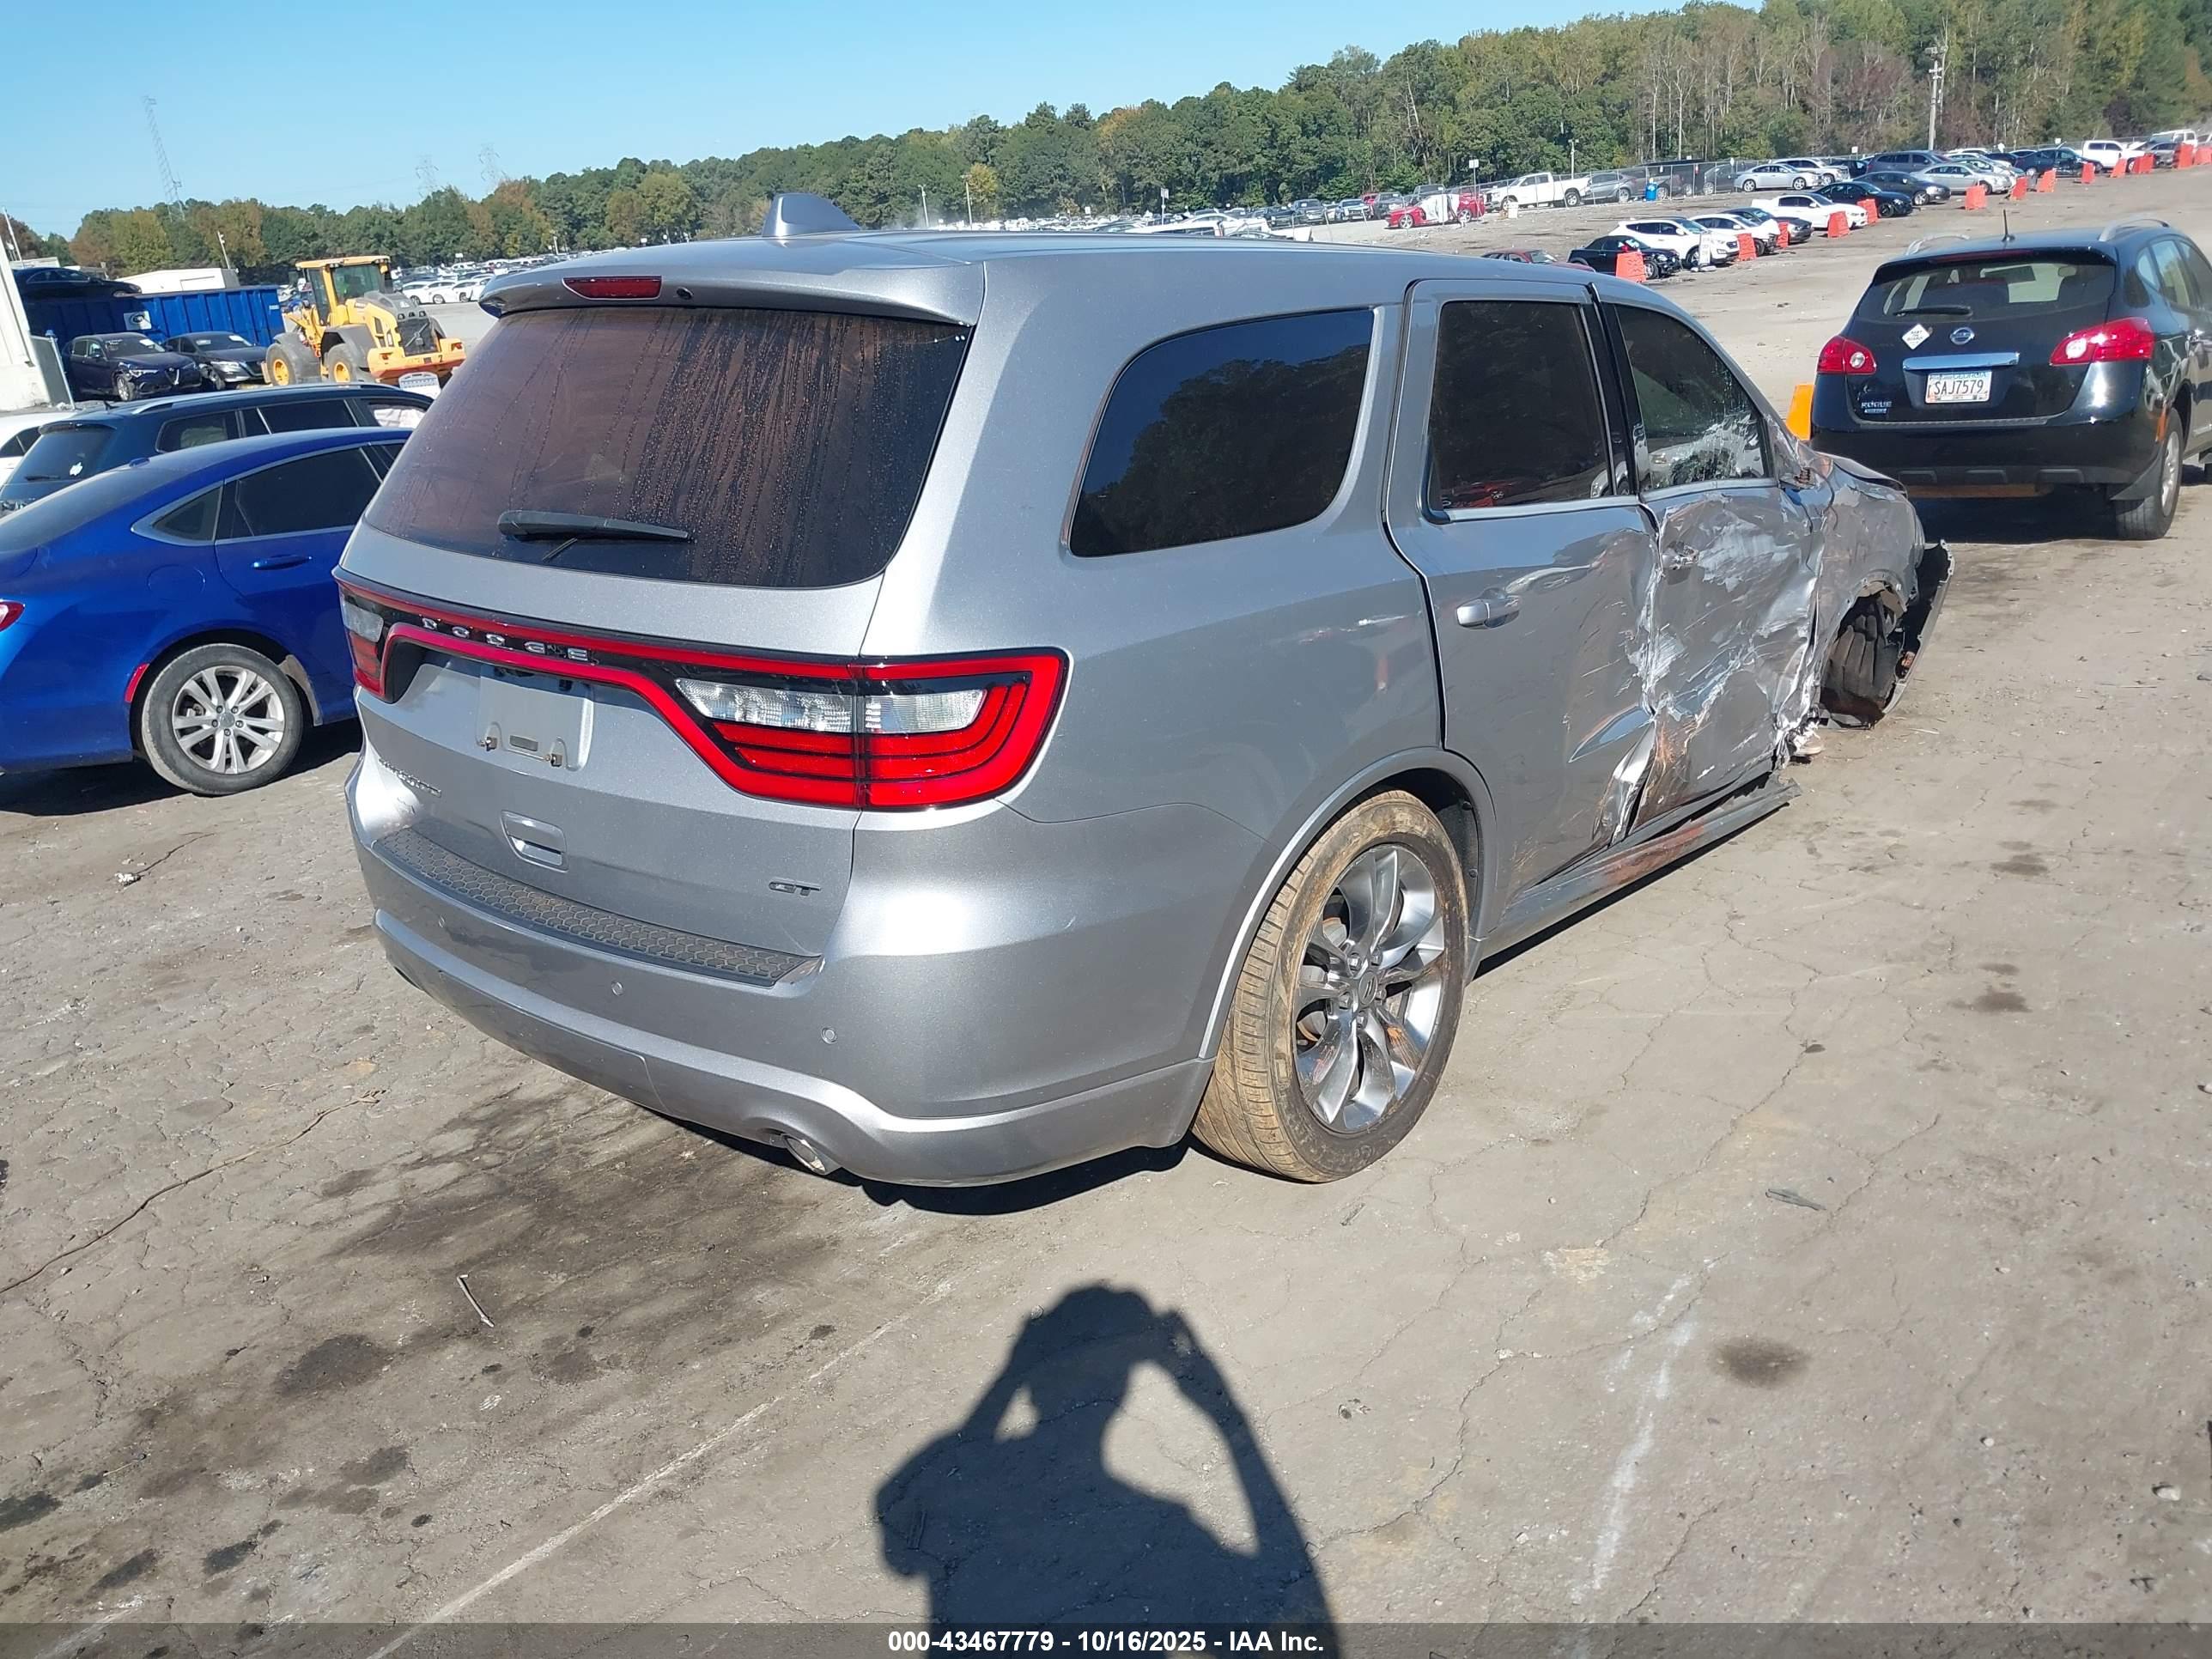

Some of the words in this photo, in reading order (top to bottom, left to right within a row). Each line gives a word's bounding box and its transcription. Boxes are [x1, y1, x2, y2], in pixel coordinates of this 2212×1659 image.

[1934, 380, 1984, 395] SAJ7579
[422, 617, 589, 661] DODGE
[769, 881, 821, 896] GT
